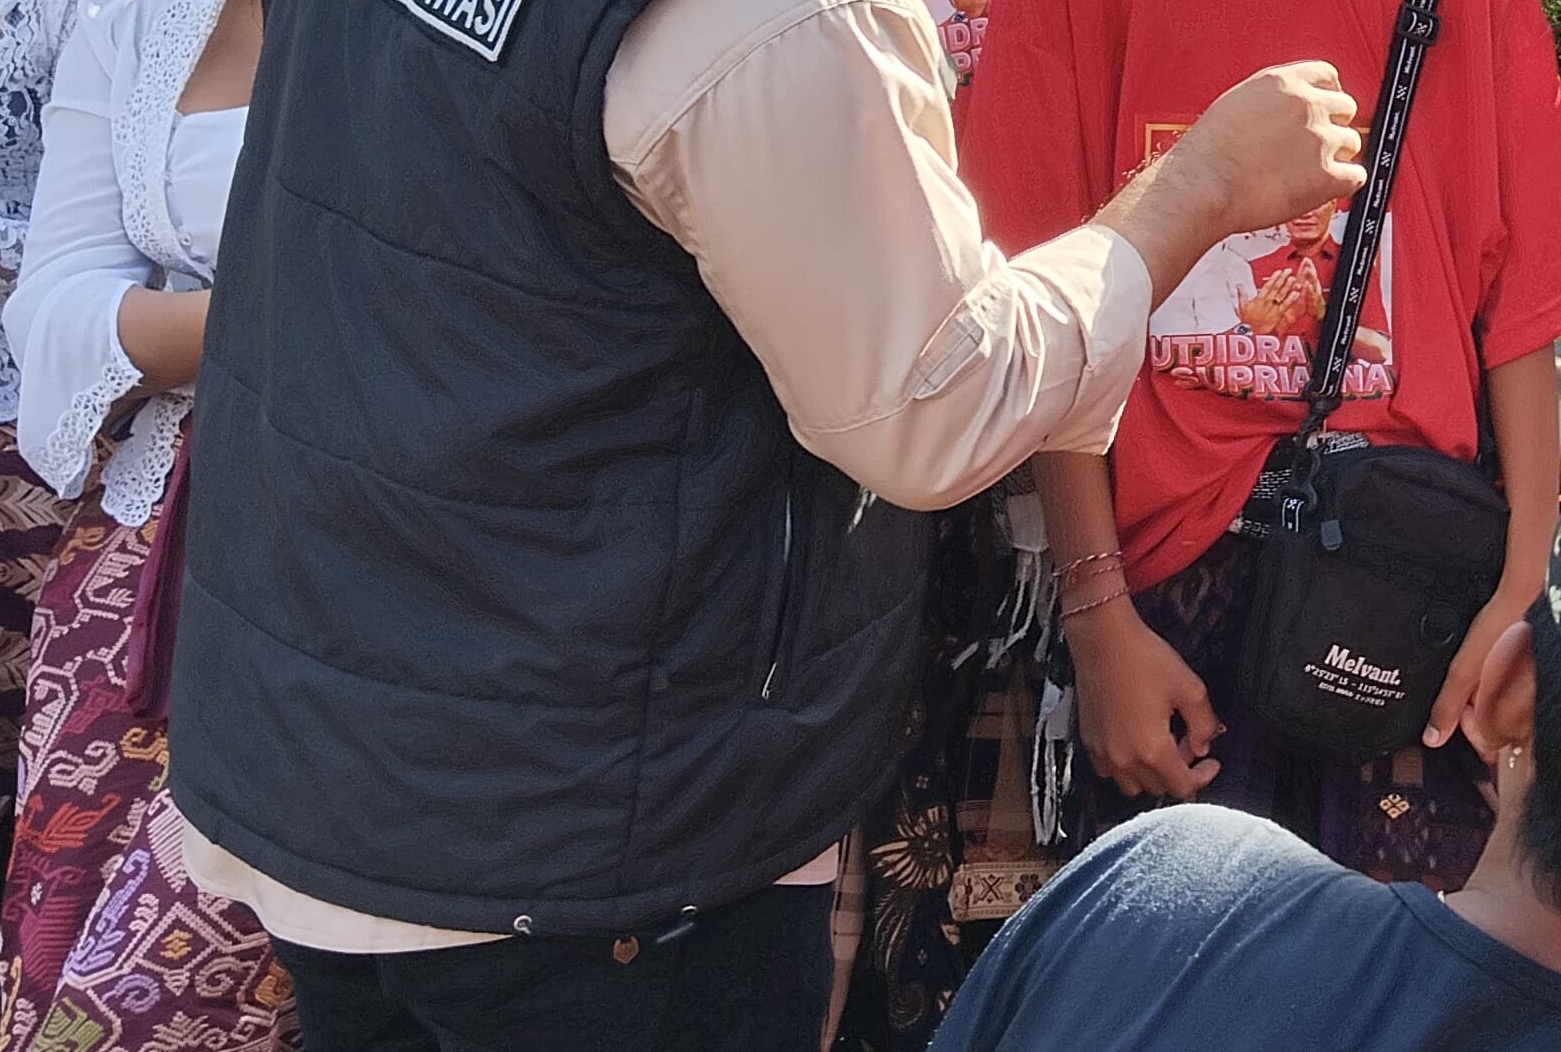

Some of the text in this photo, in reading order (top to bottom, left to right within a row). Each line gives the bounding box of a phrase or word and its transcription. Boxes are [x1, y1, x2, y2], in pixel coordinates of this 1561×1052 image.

[1150, 334, 1311, 372] UTJIDRA
[1171, 363, 1395, 400] SUPRIANA
[1324, 644, 1401, 686] Melvant.
